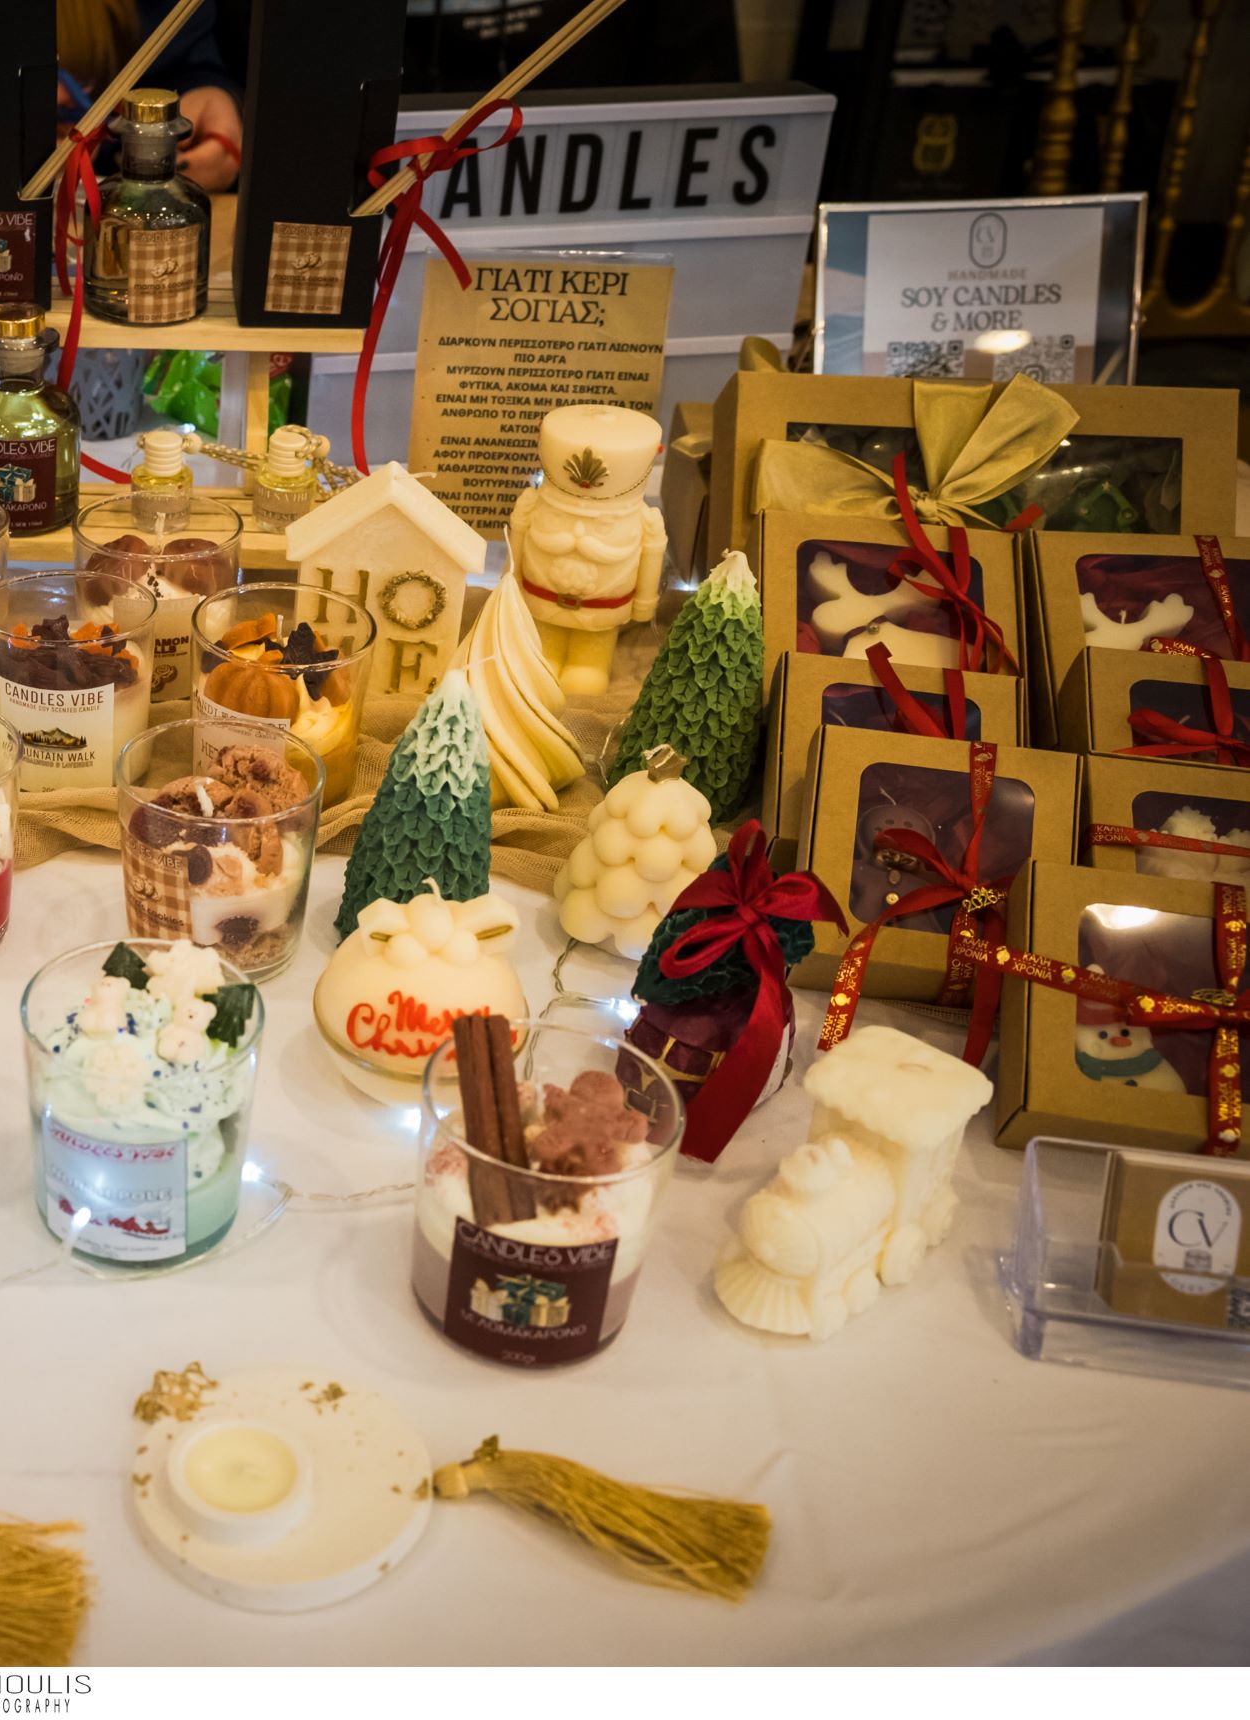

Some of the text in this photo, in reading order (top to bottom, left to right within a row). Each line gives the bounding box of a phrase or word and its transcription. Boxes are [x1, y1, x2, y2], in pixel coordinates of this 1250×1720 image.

[395, 124, 776, 218] ANDLES
[6, 212, 34, 226] VIBE
[474, 267, 630, 296] ΓΙΑΤΙ ΚΕΡΙ
[948, 268, 1029, 281] HANDMADE
[901, 284, 1062, 308] SOY CANDLES
[489, 298, 606, 327] ΣΟΓΙΑΣ;
[931, 310, 1023, 332] & MORE
[438, 336, 497, 347] ΔΙΑΡΚΟΥΝ
[499, 338, 574, 350] ΠΕΡΙΣΣΟΤΕΡΟ
[577, 341, 607, 351] ΓΙΑΤΙ
[513, 353, 567, 364] ΠΙΟ ΑΡΓΑ
[446, 365, 650, 381] ΜΥΡΙΖΟΥΝ ΠΕΡΙΣΣΟΤΕΡΟ ΓΙΑΤΙ ΕΙΝΑΙ
[505, 382, 548, 392] ΑΚΟΜΑ
[550, 383, 570, 393] ΚΑΙ
[435, 393, 467, 404] ΕΙΝΑΙ
[469, 394, 488, 405] ΜΗ
[534, 396, 552, 406] ΜΗ
[501, 410, 516, 420] ΤΟ
[29, 438, 56, 454] VIBE
[440, 436, 471, 445] ΕΙΝΑΙ
[432, 449, 540, 462] ΑΦΟΥ ΠΡΟΕΡΧΟΝΤΑ
[437, 463, 509, 475] ΚΑΘΑΡΙΖΟΥΝ
[463, 491, 494, 502] ΠΟΛΥ
[155, 635, 189, 647] AMON
[154, 646, 178, 655] LLS
[5, 682, 105, 707] CANDLES VIBE
[67, 751, 96, 762] WALK
[1093, 834, 1131, 843] ΧΡΟΝΙΑ
[158, 854, 183, 869] VIBE
[962, 937, 990, 950] ΚΑΛΗ
[953, 945, 989, 962] ΧΡΟΝΙΑ
[1021, 951, 1051, 966] ΚΑΛΗ
[1012, 962, 1053, 980] ΧΡΟΝΙΑ
[821, 1014, 834, 1041] ΚΑΛΗ
[1167, 1208, 1229, 1249] CV
[457, 1221, 563, 1267] CANDLES
[566, 1240, 617, 1266] VIBE
